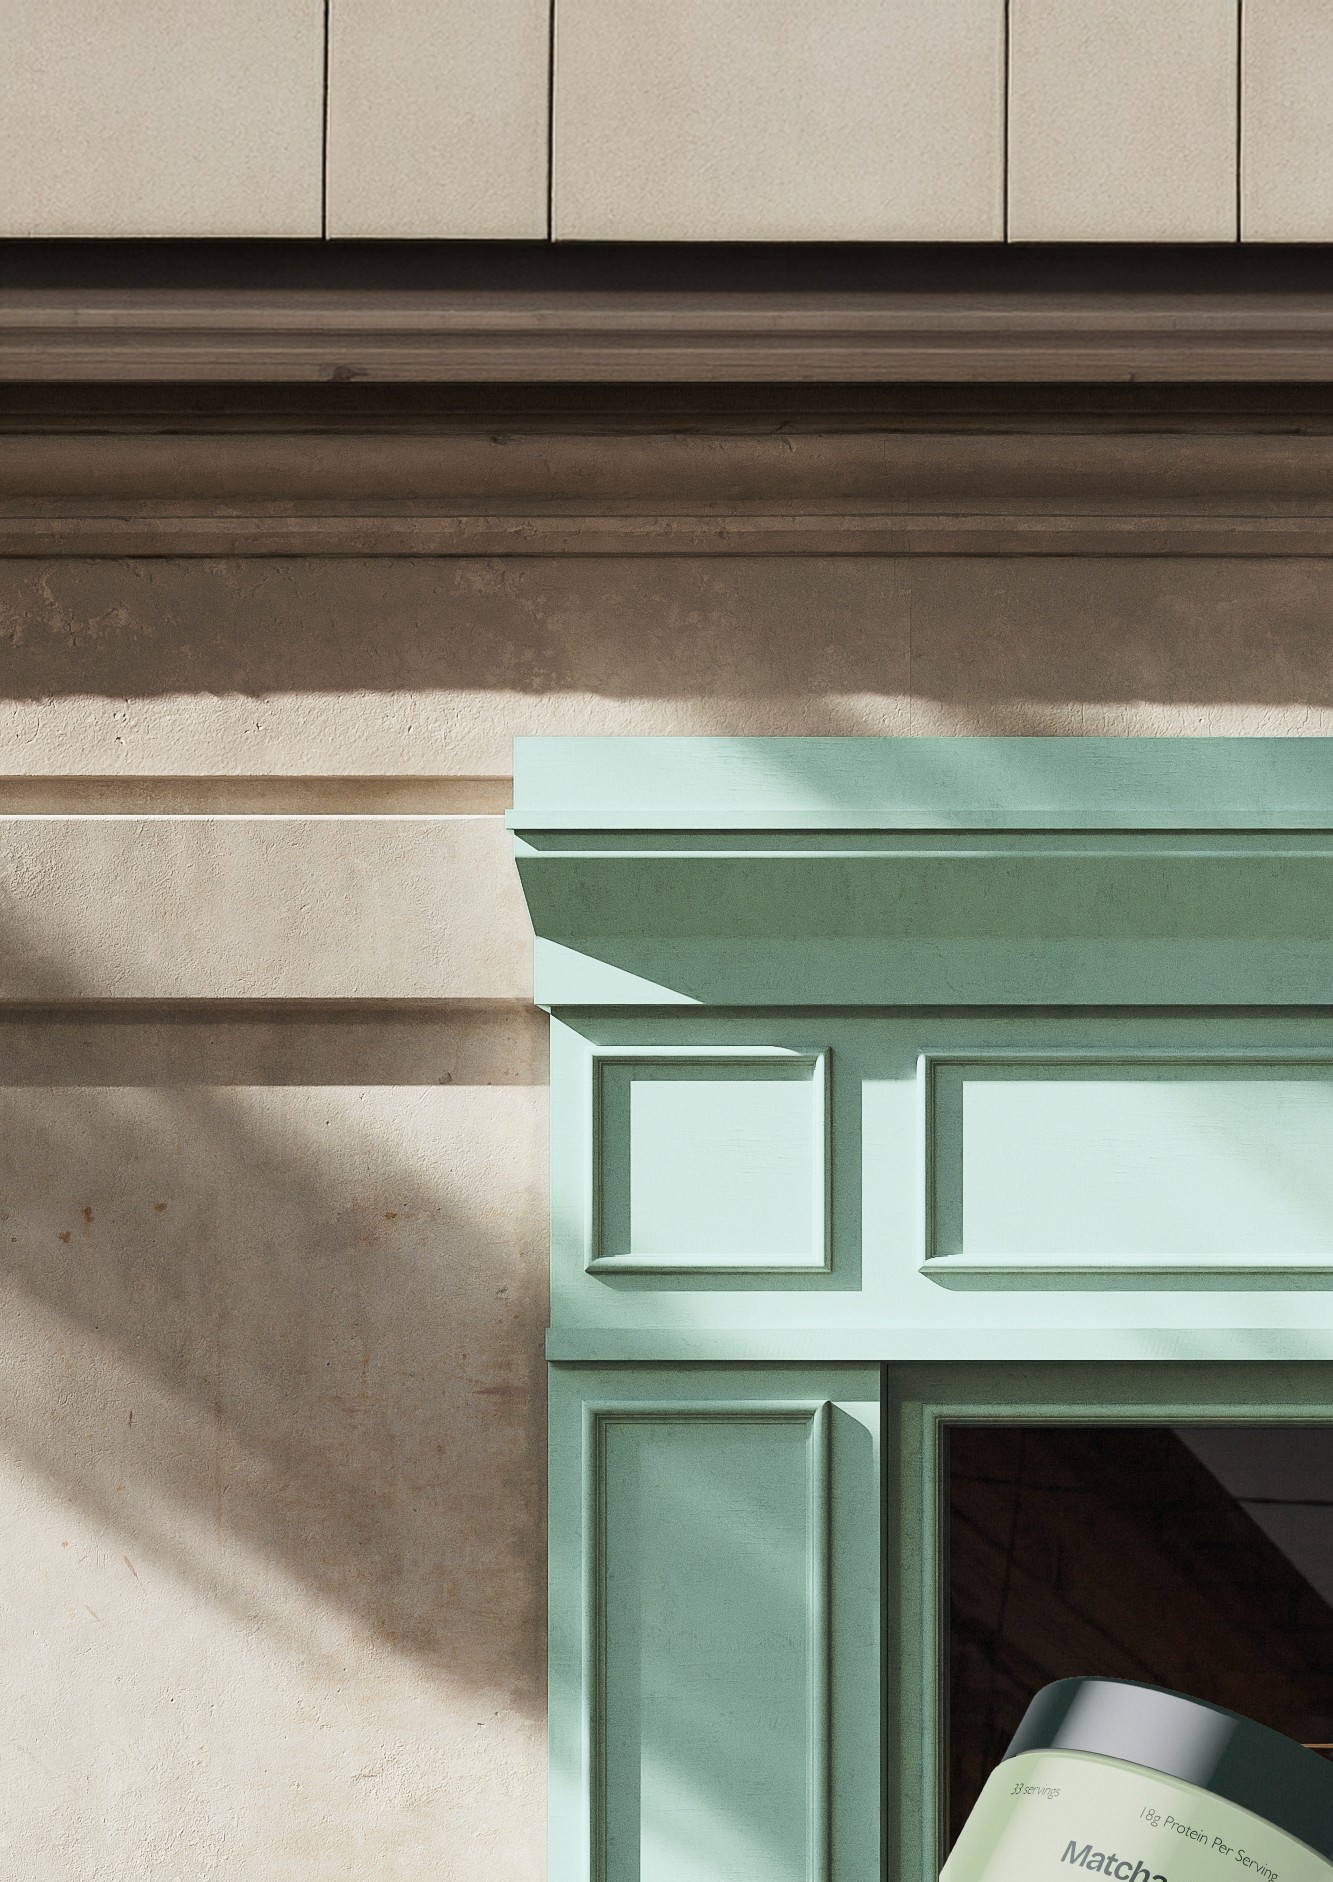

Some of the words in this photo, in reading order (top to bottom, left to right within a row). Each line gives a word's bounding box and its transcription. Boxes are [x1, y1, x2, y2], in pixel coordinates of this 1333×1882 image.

[1023, 1783, 1061, 1800] servings
[1139, 1806, 1161, 1828] 18g
[1163, 1815, 1209, 1845] Protein
[1211, 1836, 1234, 1856] Per
